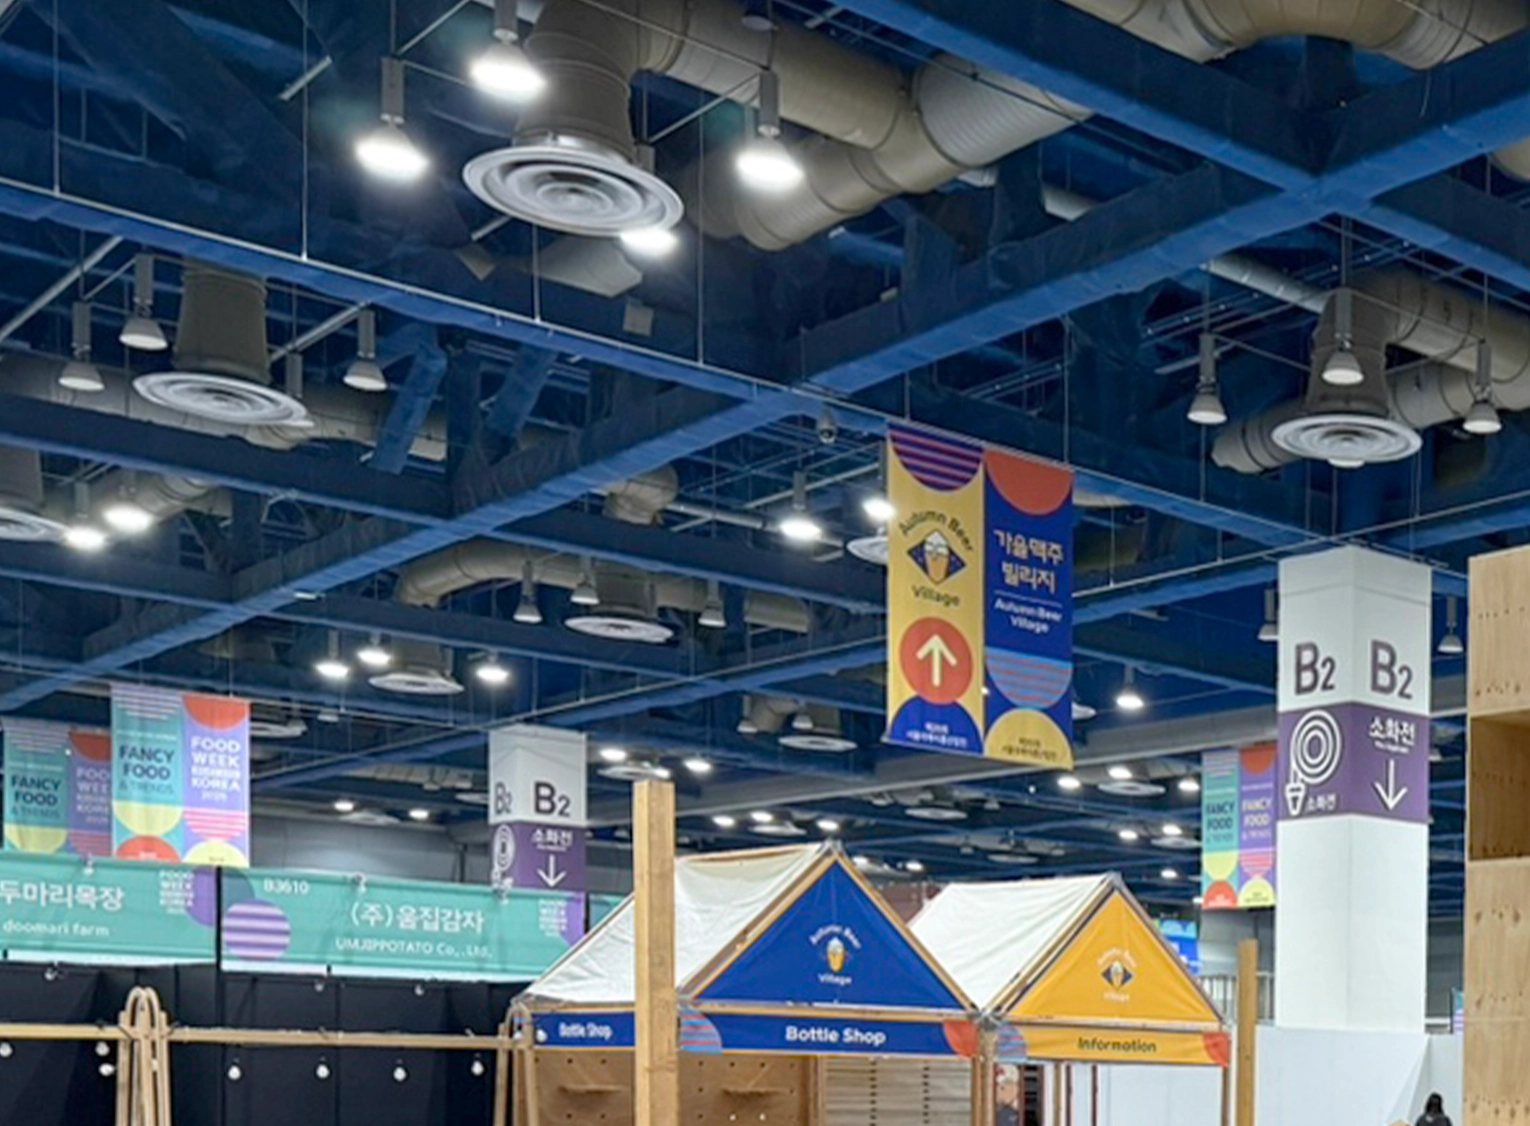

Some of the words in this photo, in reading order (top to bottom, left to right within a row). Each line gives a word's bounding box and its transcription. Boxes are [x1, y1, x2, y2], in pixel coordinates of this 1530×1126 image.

[899, 511, 947, 536] Autumn
[948, 518, 974, 551] Beer
[994, 529, 1063, 565] 가을맥주
[1002, 561, 1056, 594] 빌리지
[912, 585, 961, 607] Village
[1037, 607, 1063, 623] Beer
[1011, 615, 1050, 634] Village
[1295, 641, 1336, 695] B2
[1371, 639, 1413, 699] B2
[1369, 716, 1415, 746] 소화전
[119, 744, 175, 762] FANCY
[191, 736, 241, 753] FOOD
[192, 753, 241, 768] WEEK
[77, 767, 111, 780] FOO
[123, 763, 171, 781] FOOD
[12, 775, 61, 792] FANCY
[77, 780, 111, 793] WEE
[192, 777, 241, 792] KOREA
[15, 791, 58, 807] FOOD
[534, 781, 571, 817] B2
[0, 880, 125, 912] 두마리목장
[3, 919, 69, 935] doomari
[73, 922, 109, 936] farm
[817, 972, 852, 987] Village
[558, 1021, 585, 1038] Bottle
[586, 1021, 612, 1041] Shop
[785, 1025, 840, 1042] Bottle
[842, 1027, 887, 1048] Shop
[1078, 1037, 1157, 1052] Information
